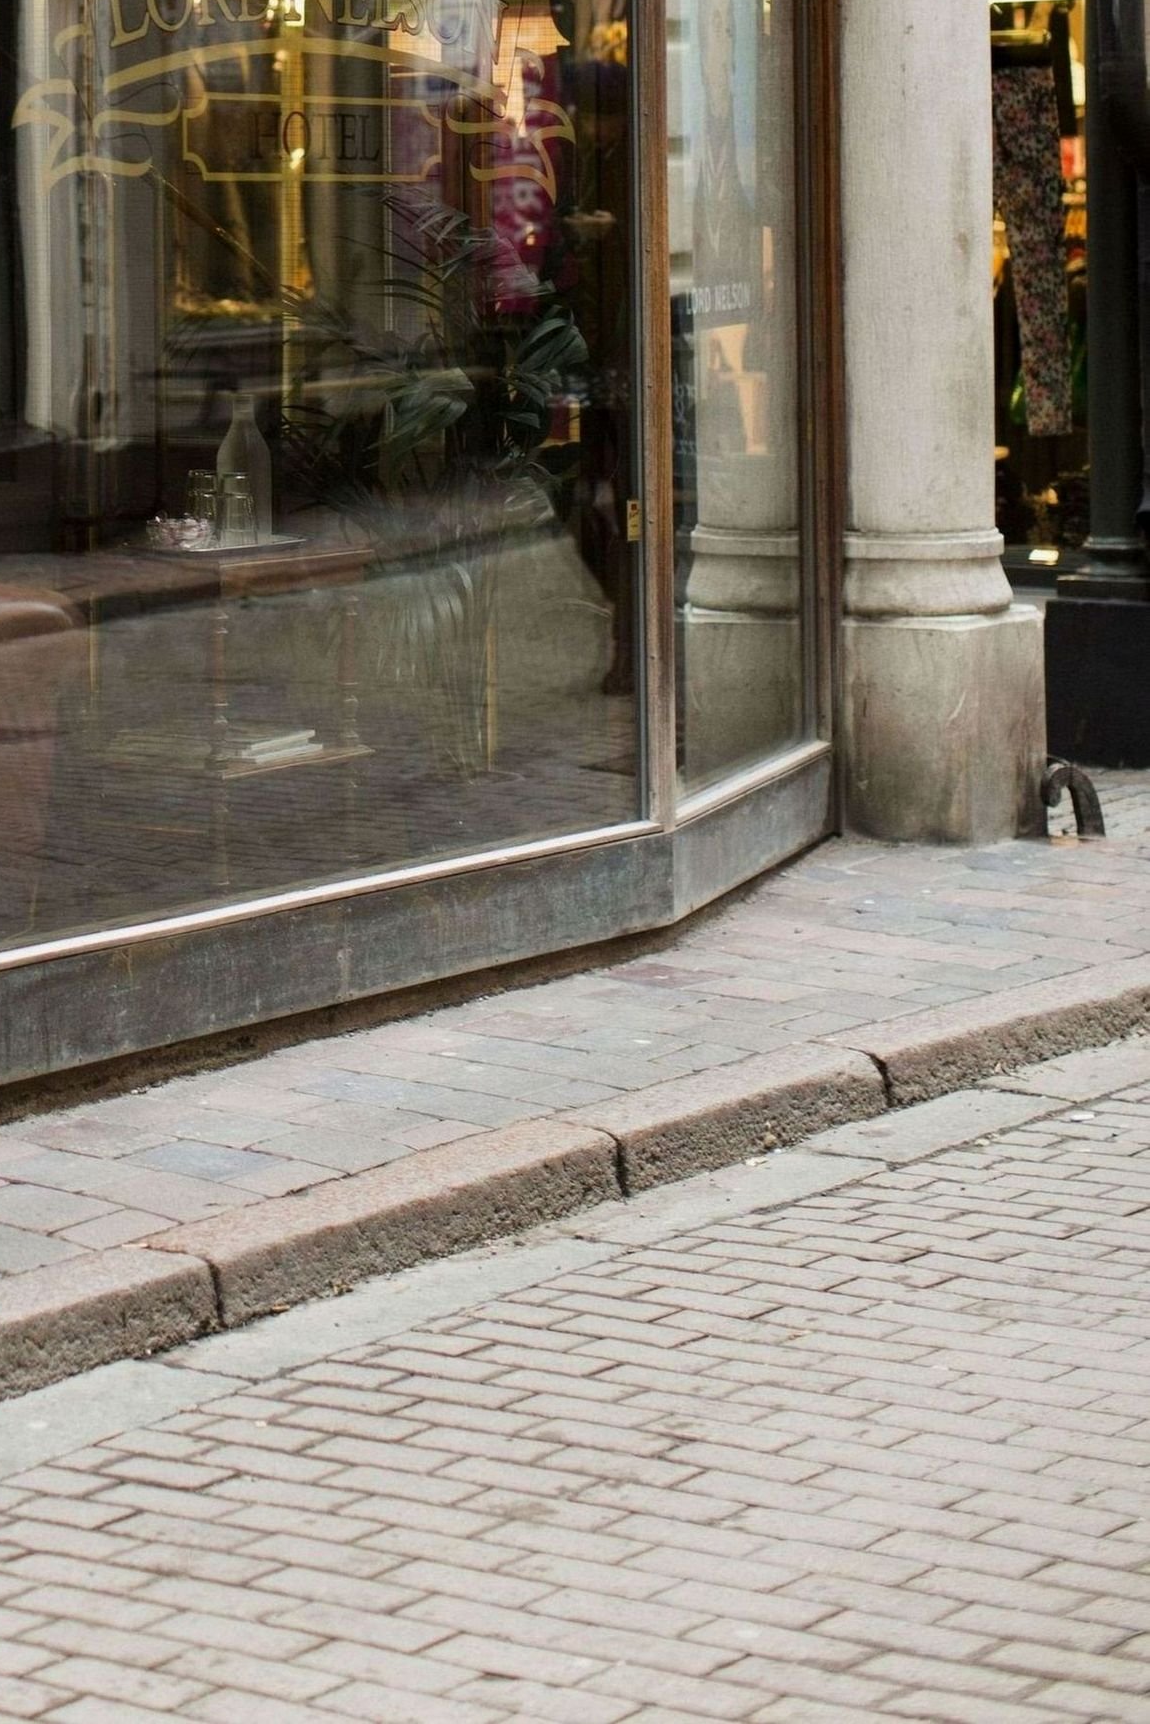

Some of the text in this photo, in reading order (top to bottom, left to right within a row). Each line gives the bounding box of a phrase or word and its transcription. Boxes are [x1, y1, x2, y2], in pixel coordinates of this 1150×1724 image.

[250, 110, 380, 162] HOTEL
[685, 281, 752, 315] LORD NELSON
